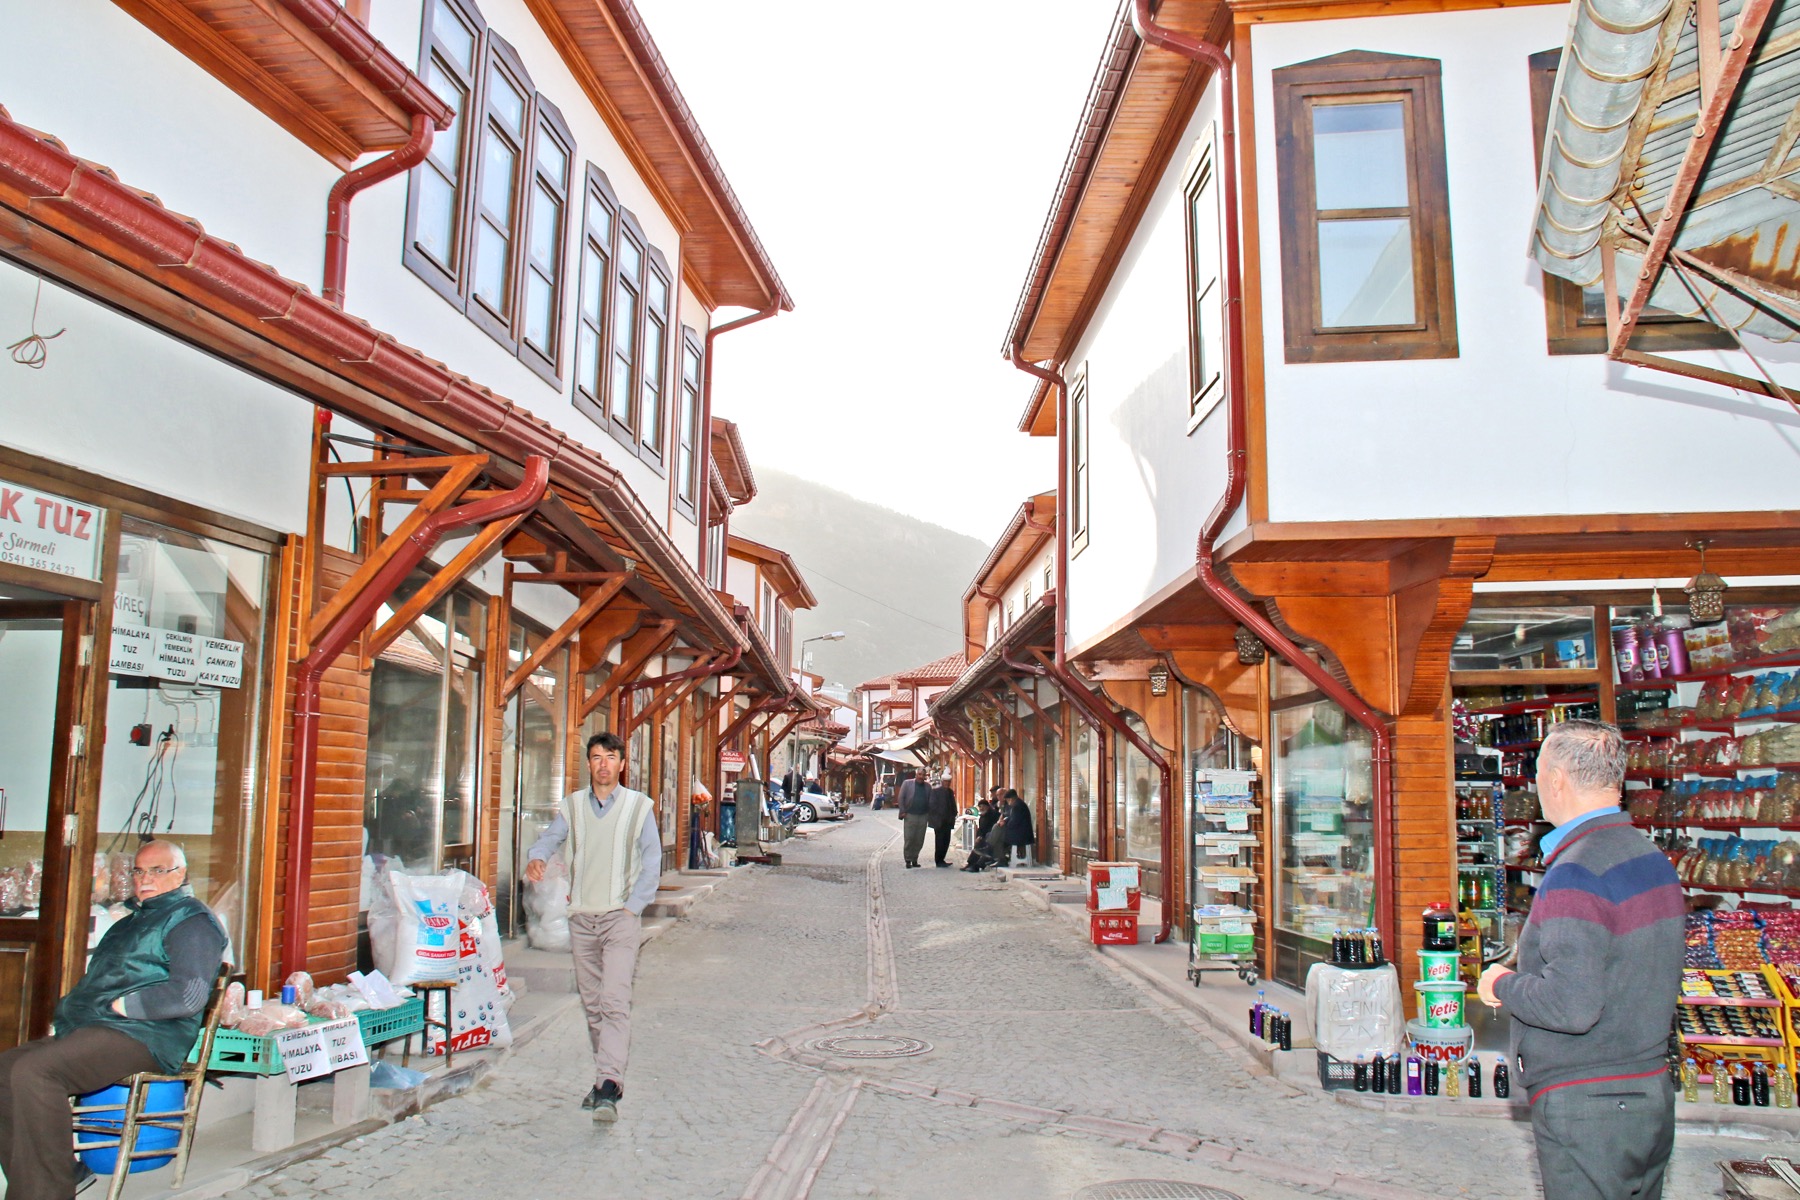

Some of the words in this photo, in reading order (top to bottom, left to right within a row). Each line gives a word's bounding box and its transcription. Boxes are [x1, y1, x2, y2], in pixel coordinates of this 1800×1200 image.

[34, 496, 92, 540] TUZ
[2, 551, 25, 564] 0541
[30, 557, 47, 569] 365
[50, 562, 62, 572] 24
[65, 565, 76, 576] 23
[112, 625, 150, 640] HİMALAYA
[122, 644, 138, 654] TUZ
[110, 659, 144, 671] LAMBASI
[159, 653, 195, 666] HİMALAYA
[206, 657, 236, 668] ÇANKIRI
[167, 667, 187, 677] TUZU
[199, 671, 219, 682] KAYA
[221, 675, 240, 685] TUZU
[332, 1036, 347, 1048] TUZ
[290, 1062, 313, 1075] TUZU
